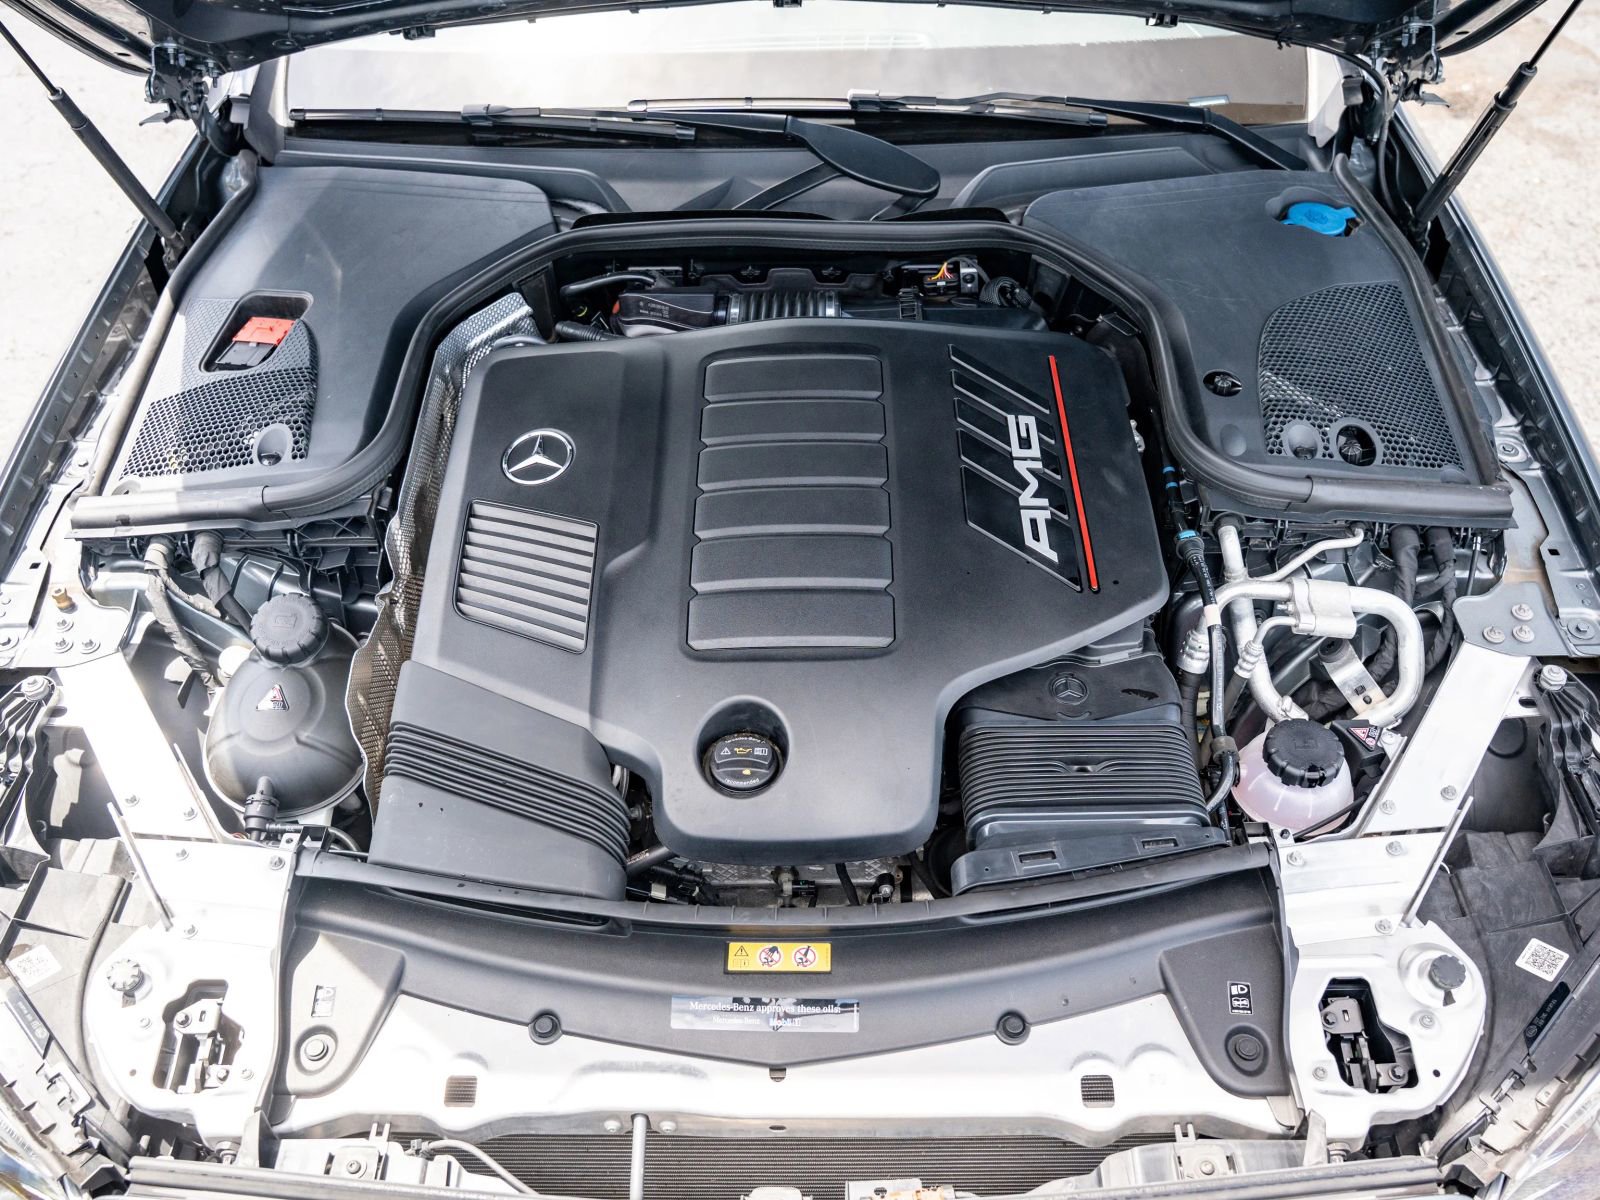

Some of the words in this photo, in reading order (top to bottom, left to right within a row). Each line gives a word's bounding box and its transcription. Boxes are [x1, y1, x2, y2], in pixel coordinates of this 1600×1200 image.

[1007, 414, 1059, 564] AMG
[689, 1001, 755, 1012] Mercedes-Benz
[756, 1005, 795, 1014] approves
[797, 1004, 822, 1013] these
[822, 1004, 841, 1013] oils:
